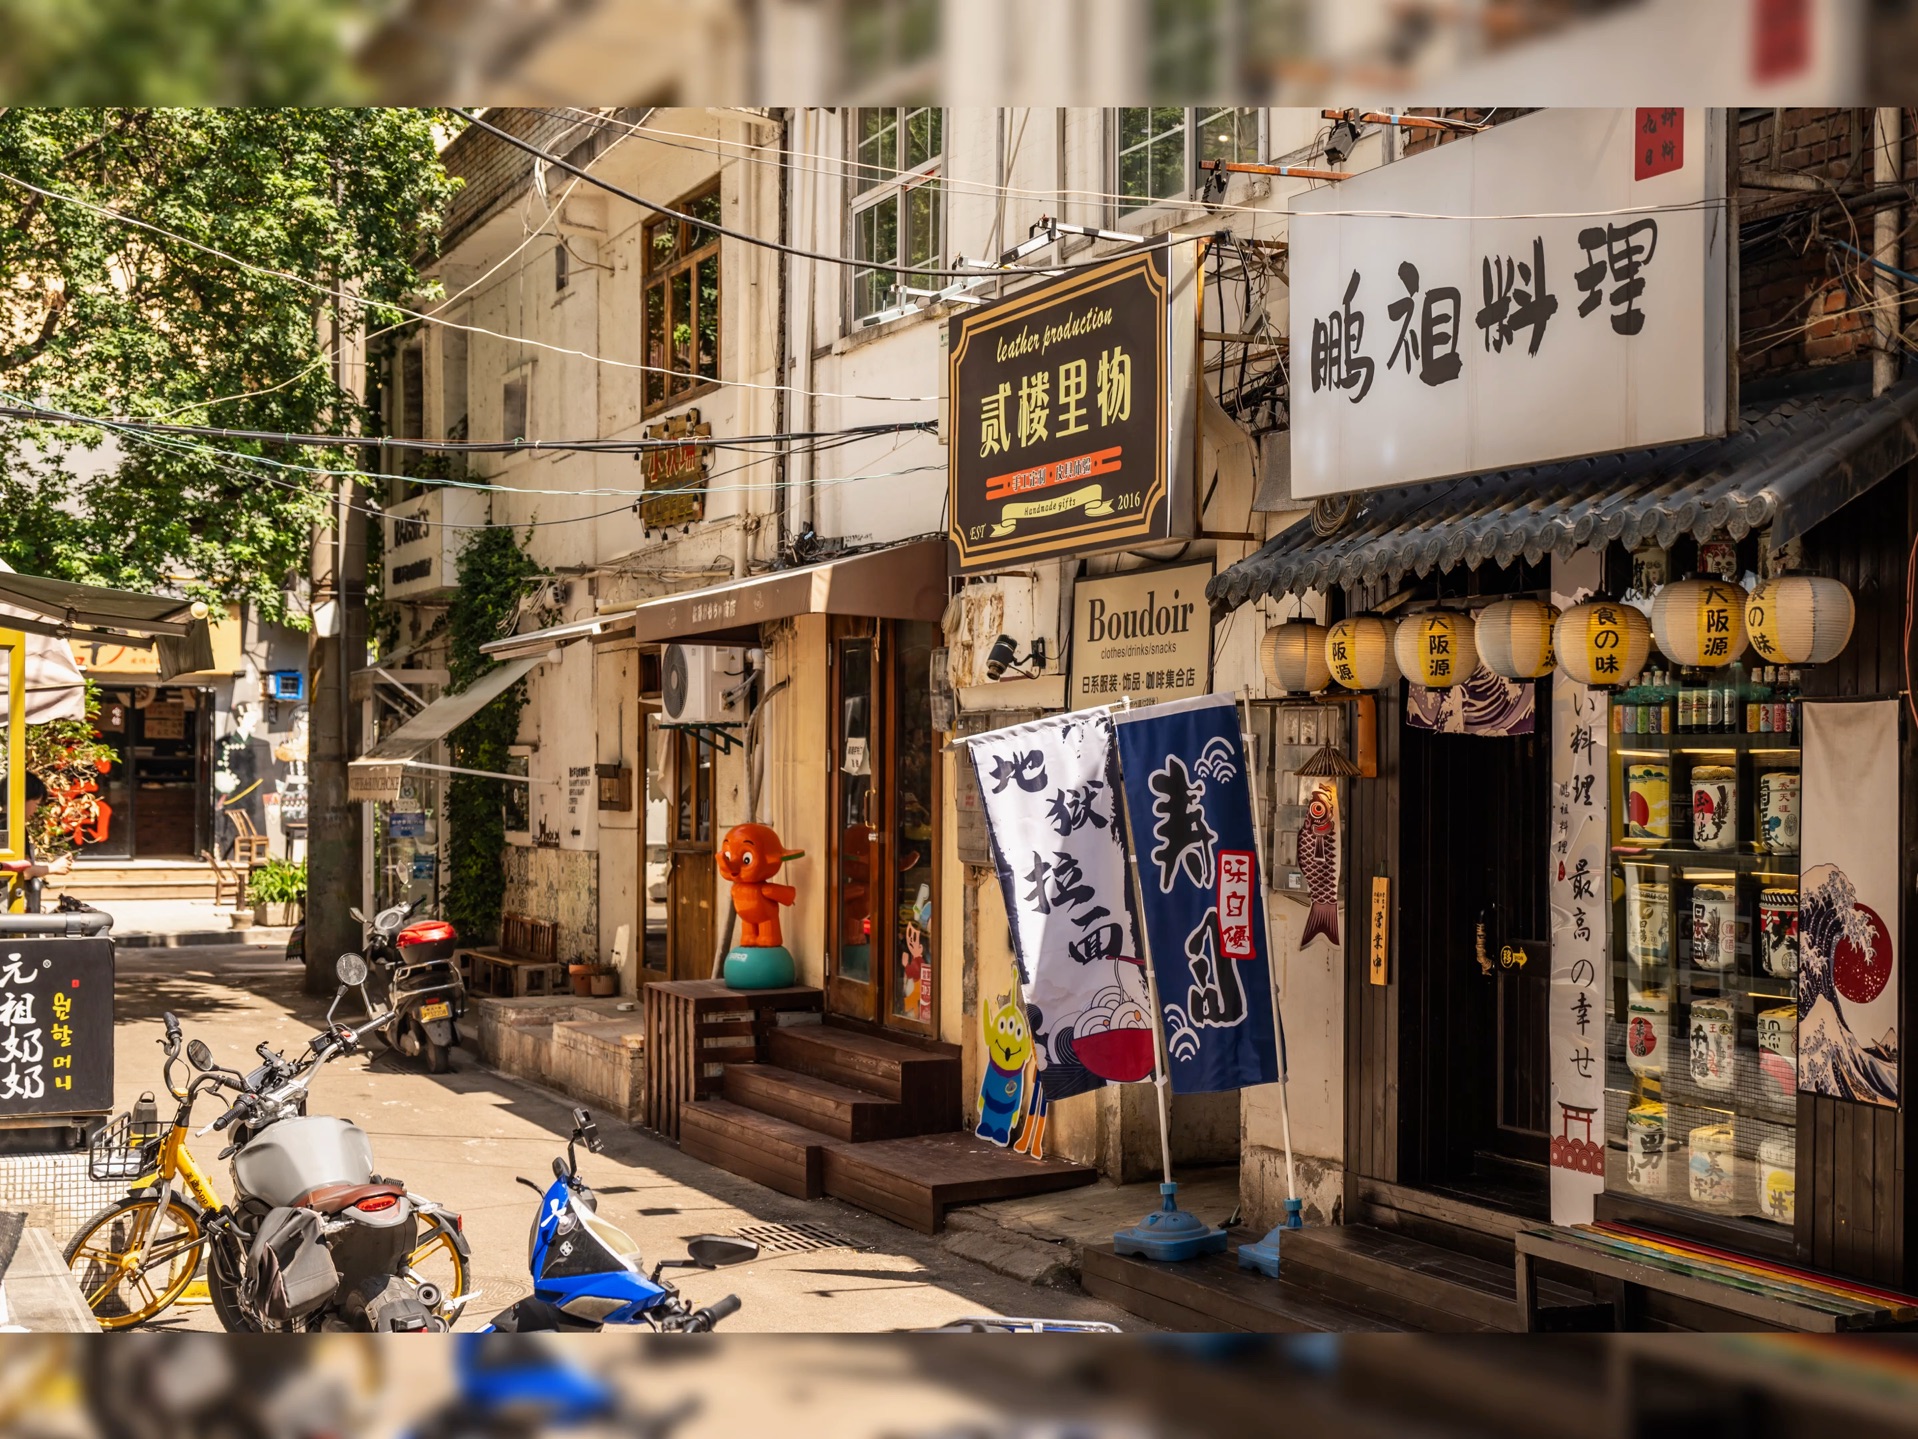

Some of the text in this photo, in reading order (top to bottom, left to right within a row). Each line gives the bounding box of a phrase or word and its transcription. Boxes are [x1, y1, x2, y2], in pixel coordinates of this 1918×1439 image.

[996, 307, 1113, 363] leather production
[979, 345, 1132, 458] 贰楼里物
[1024, 497, 1076, 516] Handmade gifts
[1117, 491, 1141, 511] 2016
[969, 523, 987, 541] EST
[1087, 588, 1194, 642] Boudoir
[1592, 606, 1620, 674] 食の味
[1702, 585, 1729, 657] 大阪源
[1100, 641, 1177, 660] clothes/drinks/snacks
[1332, 621, 1355, 681] 大阪源
[1426, 615, 1451, 677] 大阪源
[0, 953, 45, 1099] 元祖奶奶
[50, 992, 73, 1091] 원할머니
